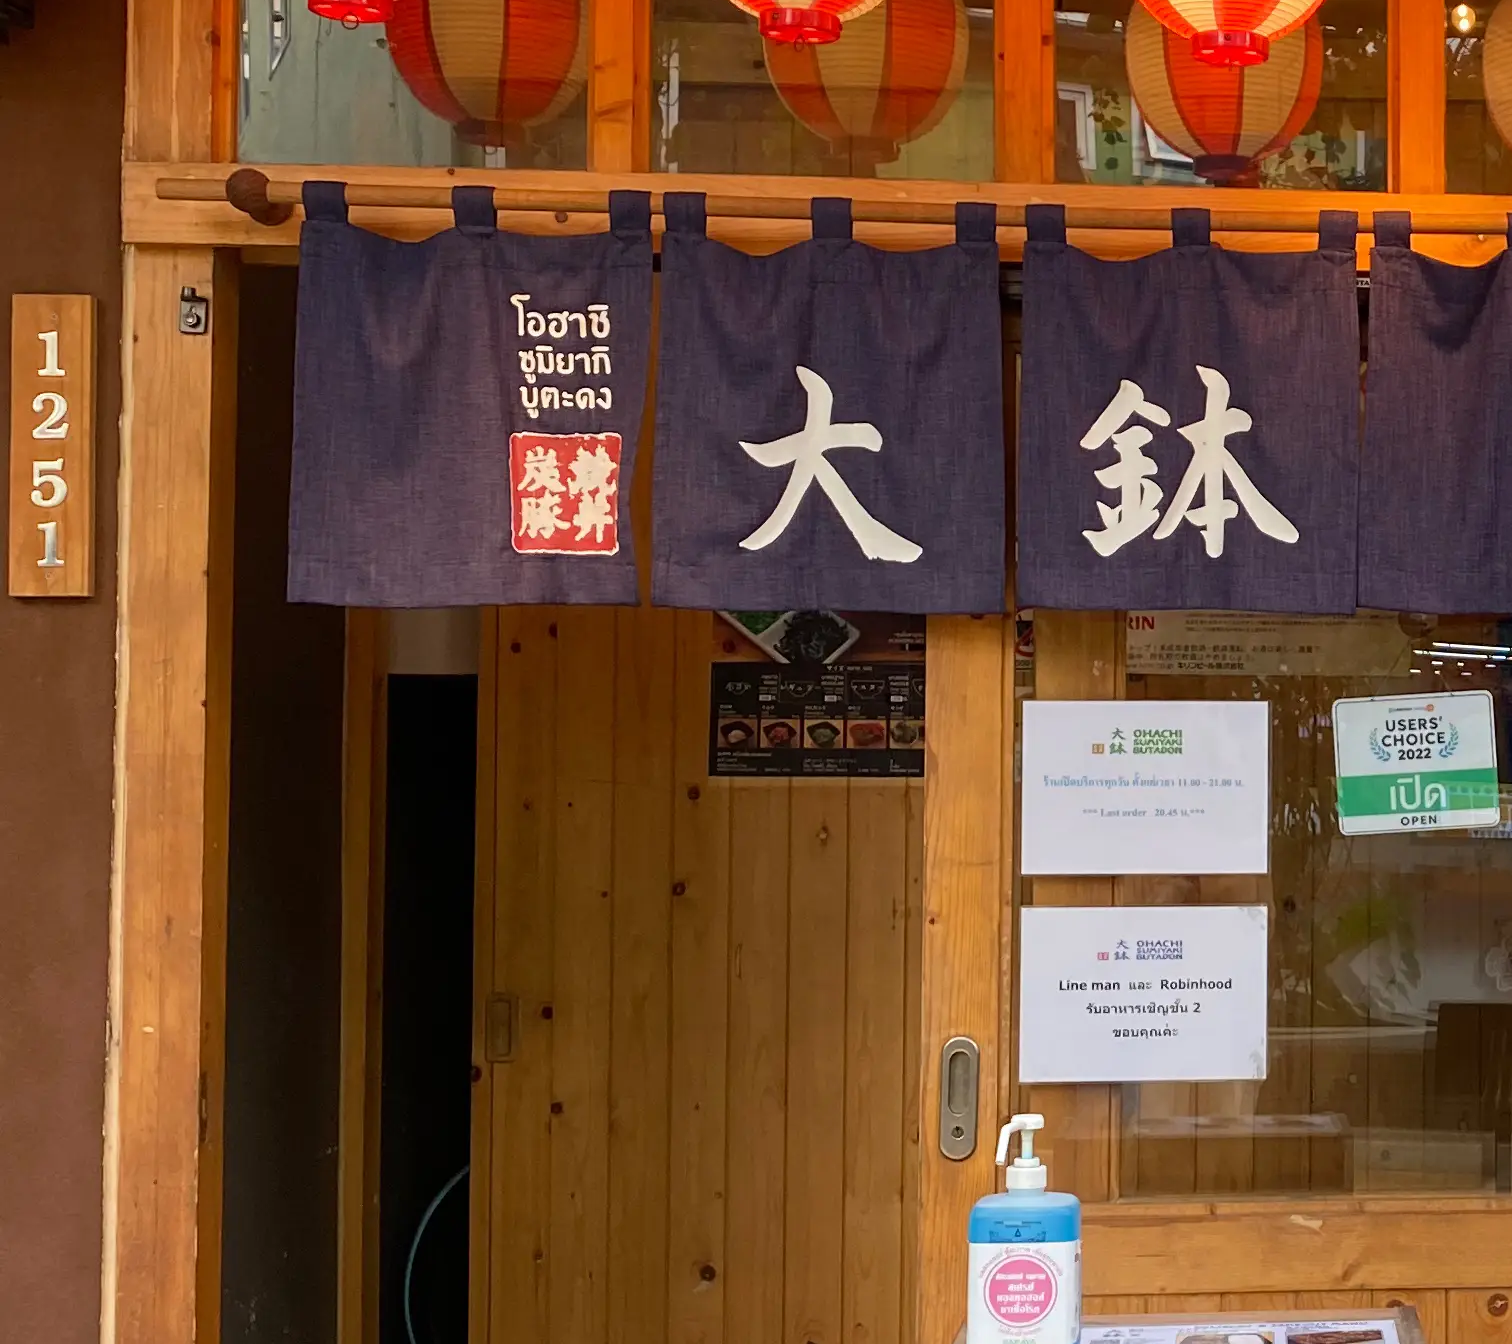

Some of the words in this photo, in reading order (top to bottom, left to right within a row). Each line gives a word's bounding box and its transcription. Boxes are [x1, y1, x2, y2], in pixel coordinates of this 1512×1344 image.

[510, 294, 611, 338] โอฮาชิ
[518, 346, 612, 384] ซูมิยากิ
[519, 386, 613, 419] บูตะดง
[31, 331, 69, 567] 1251
[1133, 729, 1183, 738] OHACHI
[1381, 732, 1446, 747] CHOICE
[1398, 748, 1432, 761] 2022
[1389, 774, 1447, 811] เปิด
[1100, 808, 1120, 817] Last
[1122, 808, 1147, 817] order
[1155, 808, 1178, 817] 20.45
[1400, 814, 1437, 826] OPEN
[1136, 939, 1183, 947] OHACHI
[1059, 979, 1087, 991] Line
[1091, 981, 1120, 991] man
[1128, 981, 1152, 990] และ
[1160, 978, 1232, 990] Robinhood
[1193, 1002, 1201, 1013] 2
[1112, 1024, 1178, 1039] ขอบคุณค่ะ
